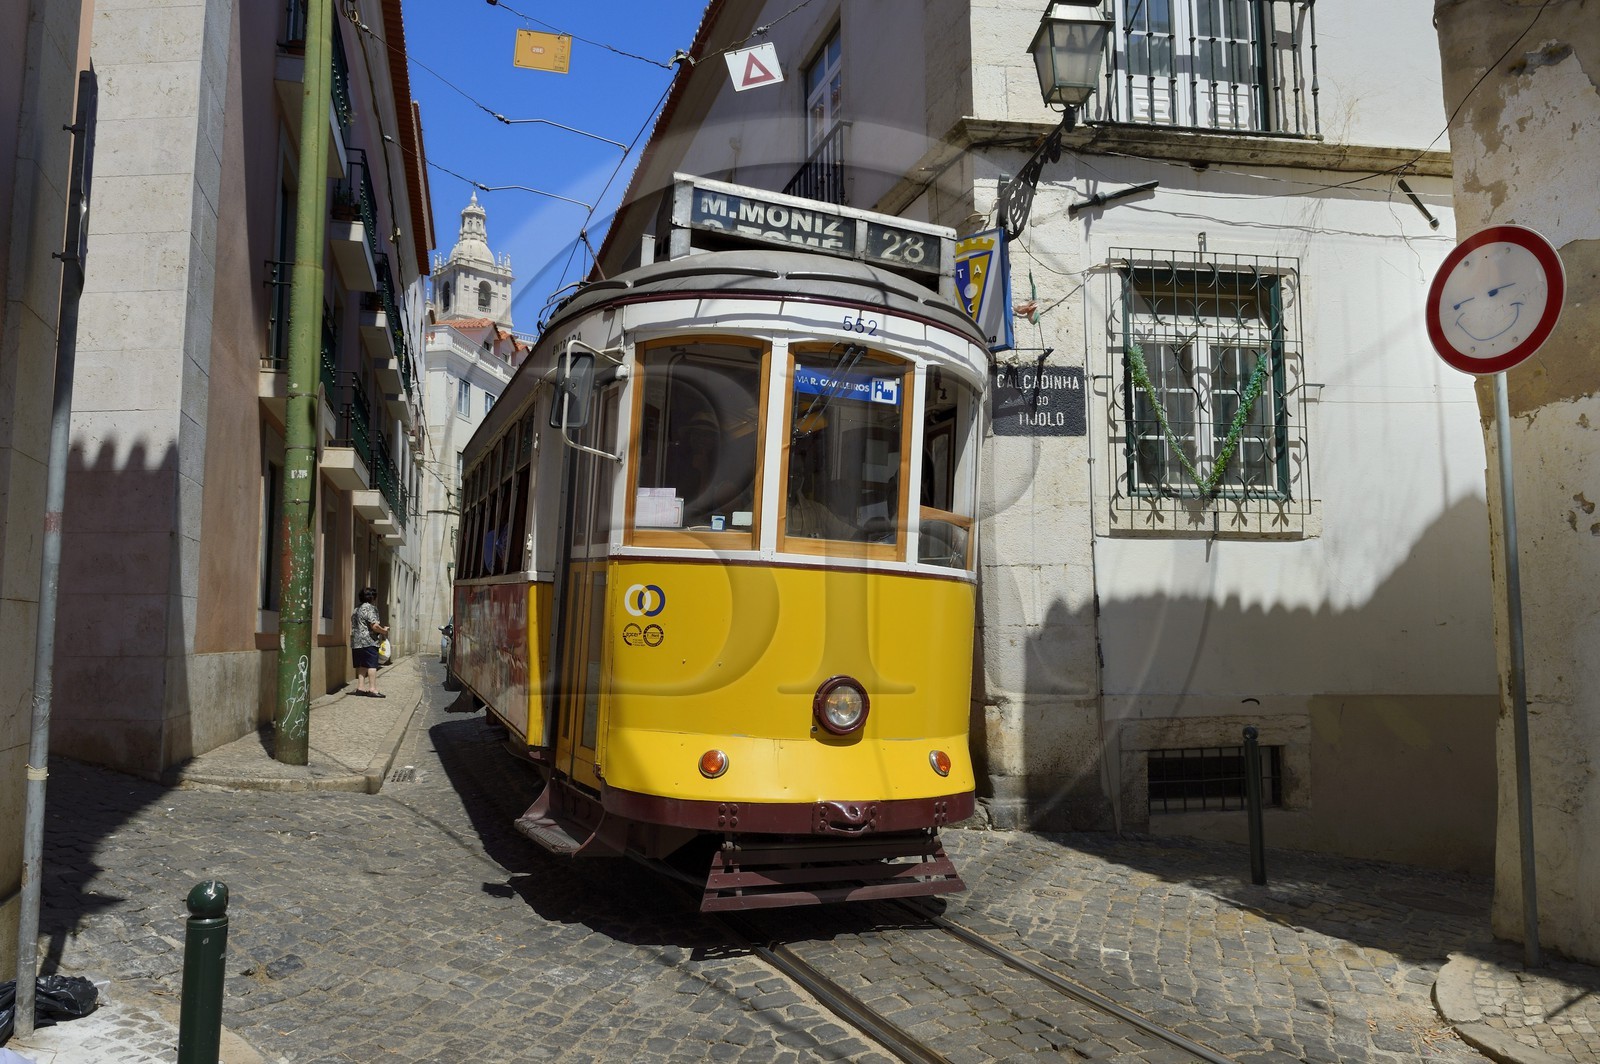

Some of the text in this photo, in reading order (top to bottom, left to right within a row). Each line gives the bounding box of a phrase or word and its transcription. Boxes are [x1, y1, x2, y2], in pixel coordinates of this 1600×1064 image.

[701, 194, 844, 237] M.MONIZ
[881, 230, 925, 263] 28
[842, 316, 878, 337] 552
[797, 375, 809, 383] VIA
[810, 377, 818, 386] R.
[997, 374, 1080, 393] CALÇADINHA
[1018, 411, 1064, 426] TIJOLO
